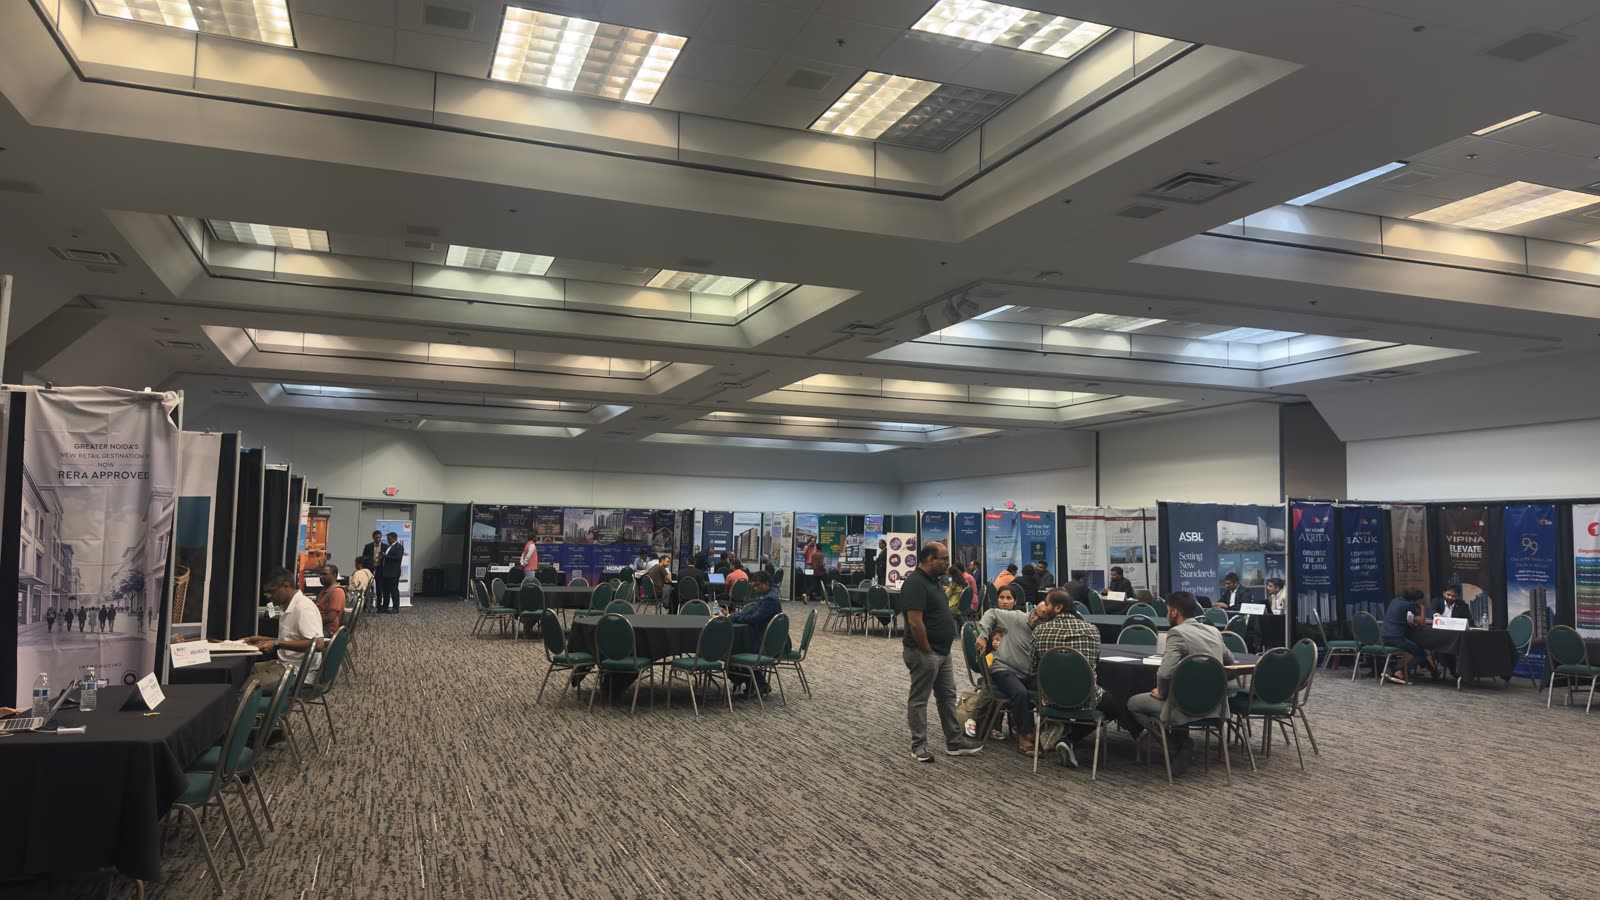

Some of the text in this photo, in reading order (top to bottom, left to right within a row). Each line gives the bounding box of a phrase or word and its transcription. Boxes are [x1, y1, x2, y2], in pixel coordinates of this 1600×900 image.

[58, 470, 150, 480] RERA APPROVED
[1178, 532, 1204, 542] ASBL
[1346, 536, 1378, 544] SAYUK
[1450, 544, 1482, 553] ELEVATE
[1522, 537, 1538, 556] 99
[1178, 552, 1204, 562] Setting
[1180, 560, 1196, 568] New
[1180, 568, 1217, 578] Standards
